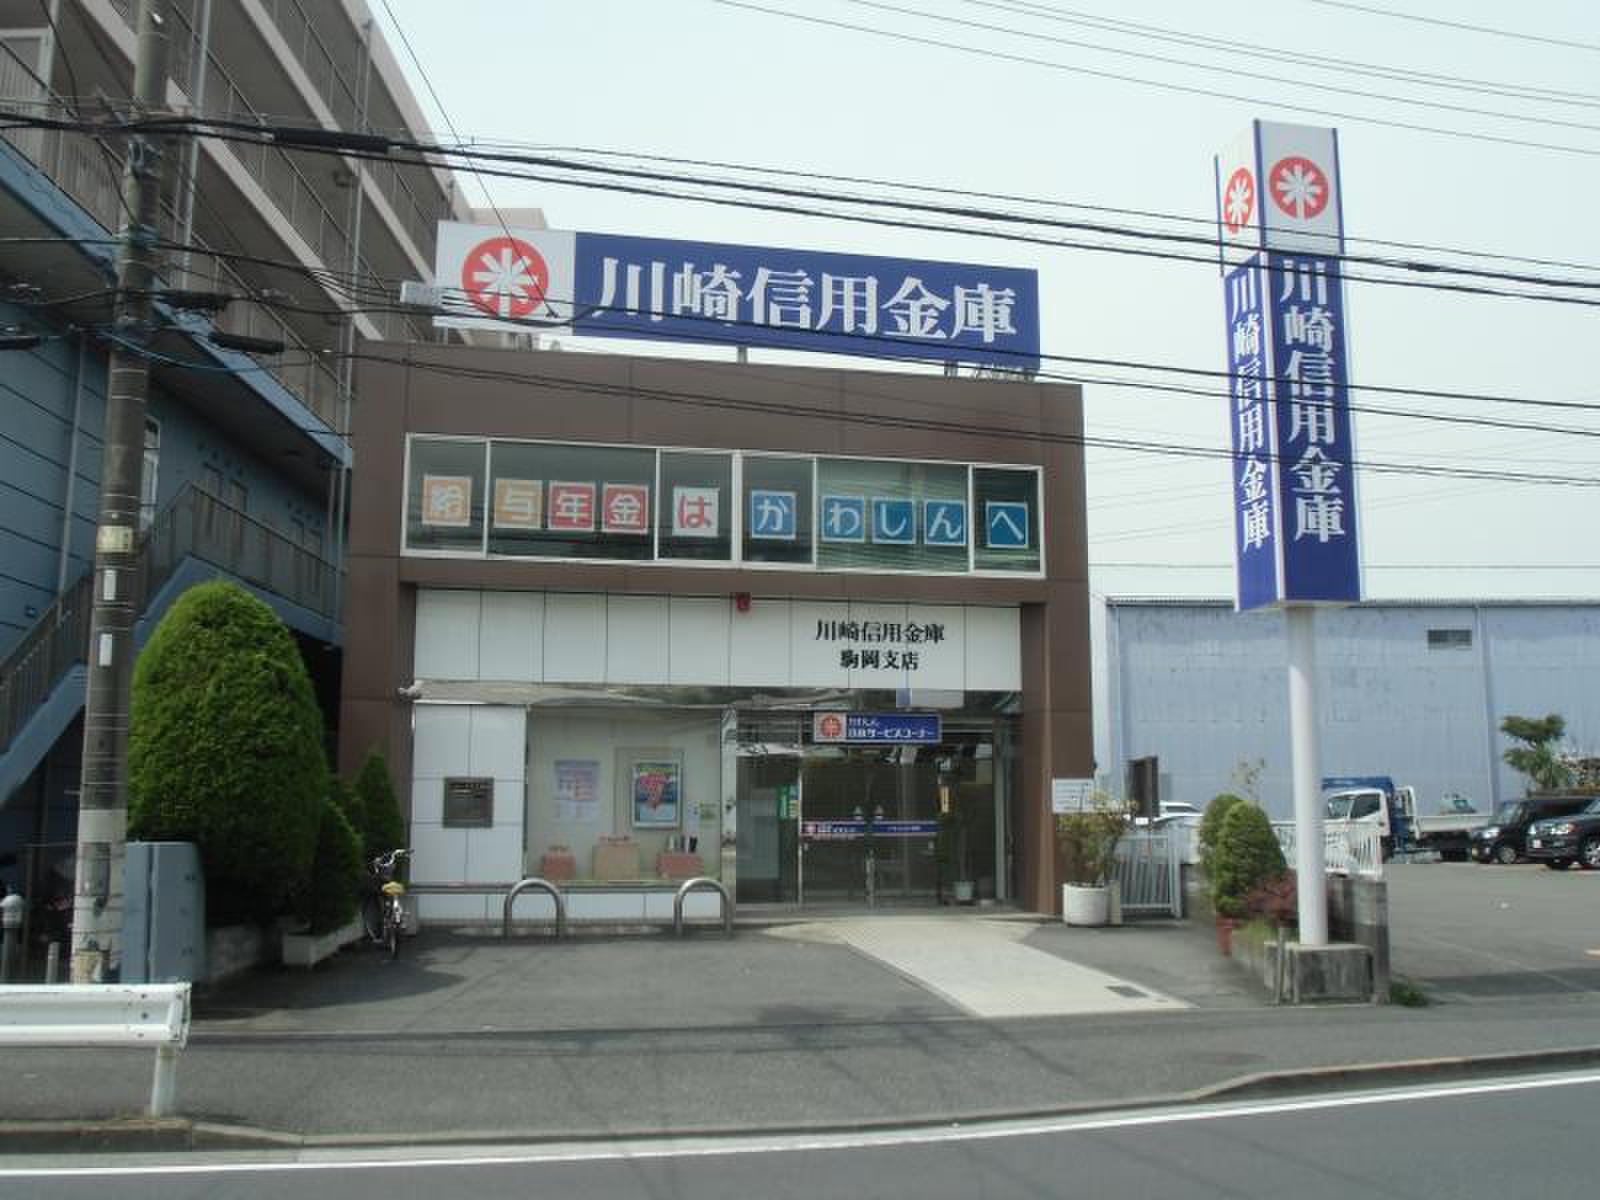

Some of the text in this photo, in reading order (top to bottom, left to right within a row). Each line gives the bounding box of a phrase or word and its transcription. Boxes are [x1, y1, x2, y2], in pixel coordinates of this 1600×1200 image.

[592, 257, 1017, 343] 川崎信用金庫
[1231, 270, 1270, 553] 川崎信用金庫
[1280, 260, 1346, 543] 川崎信用金庫
[816, 620, 945, 643] 川崎信用金庫
[840, 649, 919, 671] 駒岡支店
